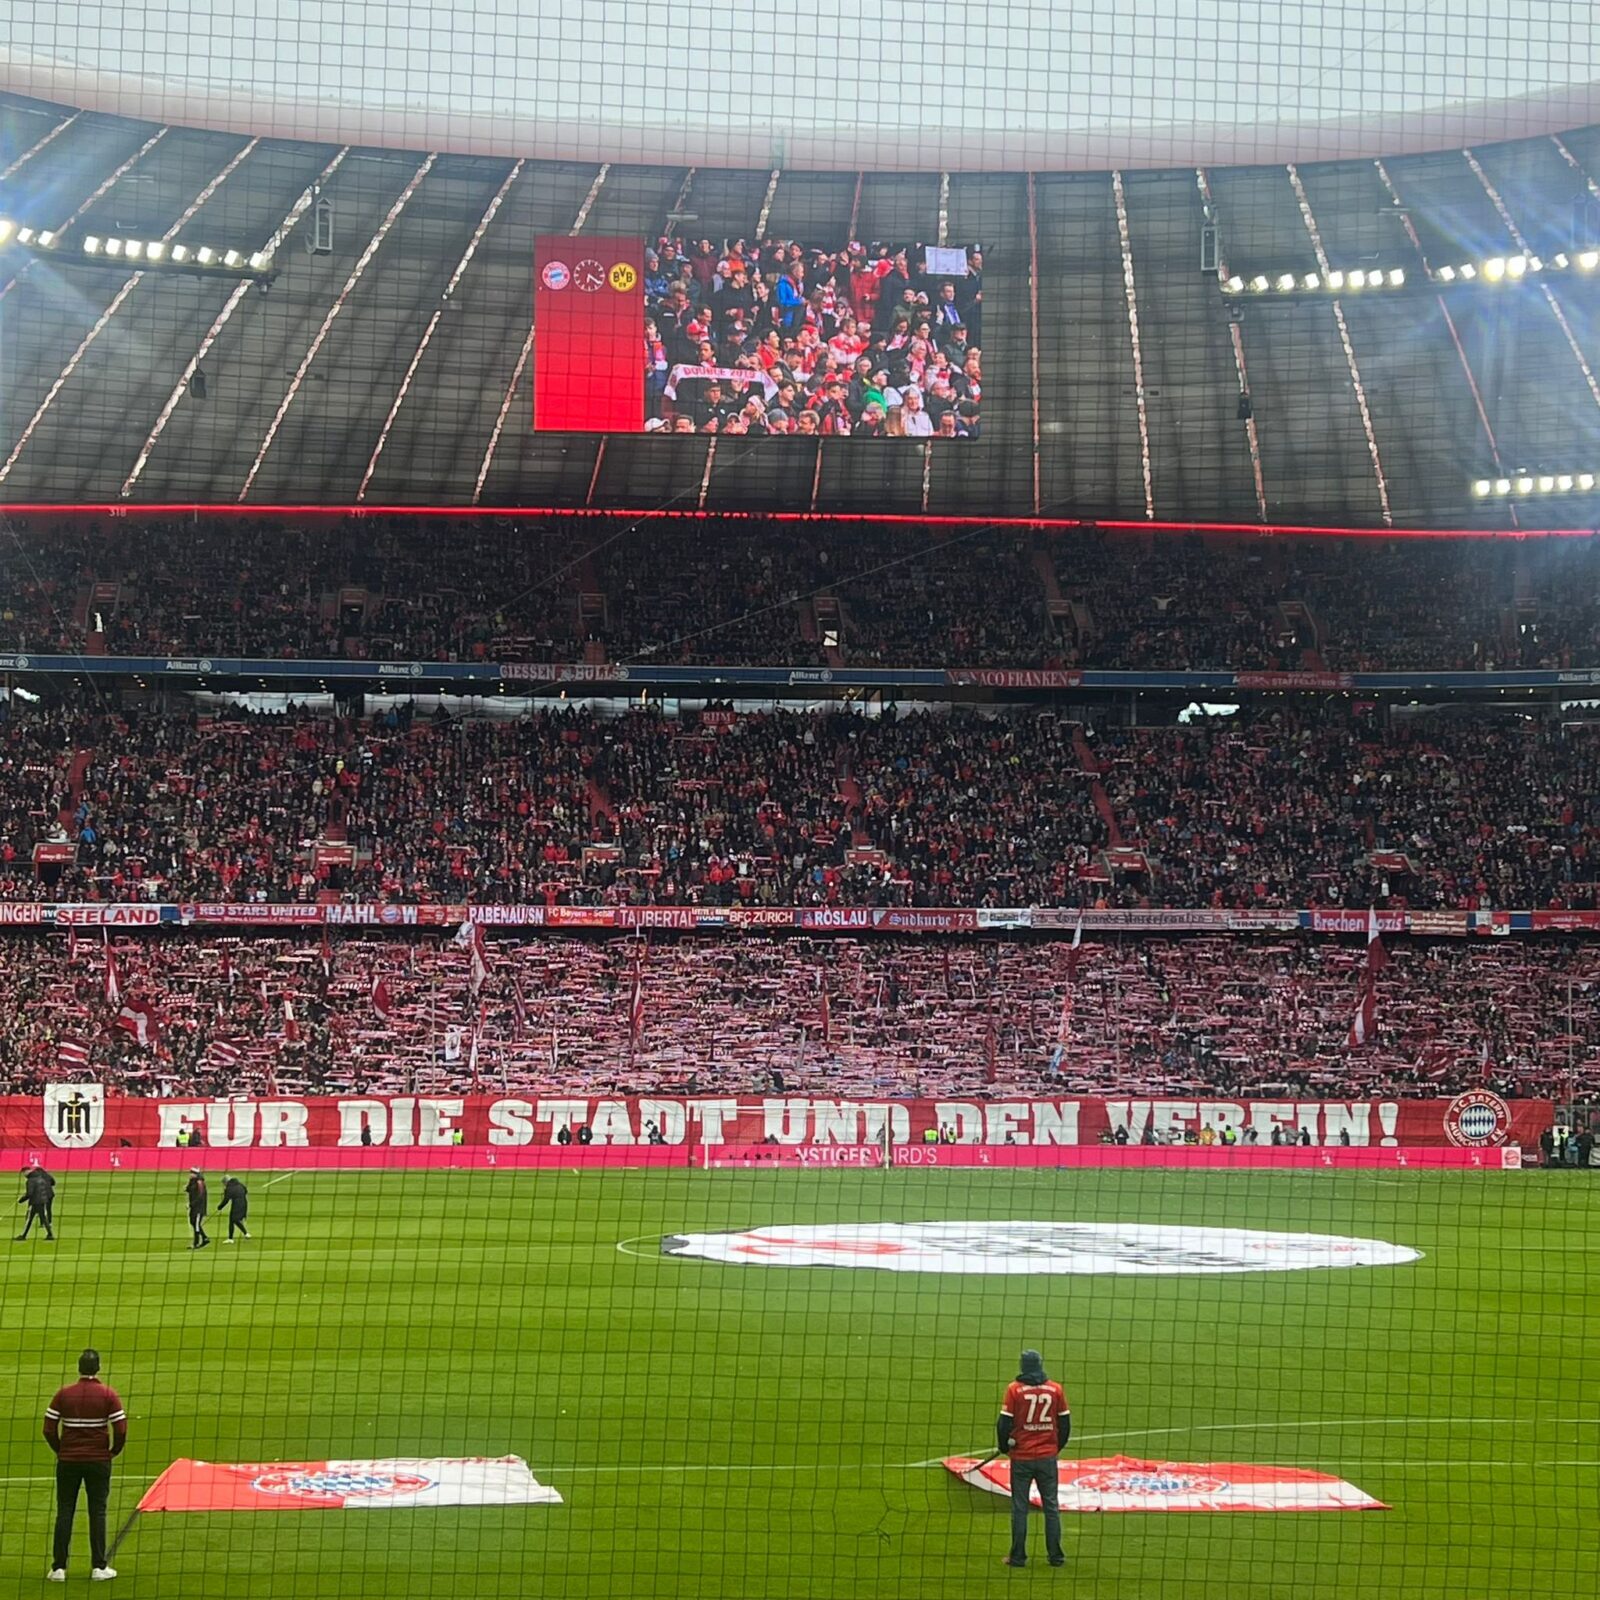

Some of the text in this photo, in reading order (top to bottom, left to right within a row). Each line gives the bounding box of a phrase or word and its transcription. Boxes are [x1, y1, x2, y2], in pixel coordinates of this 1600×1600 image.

[613, 266, 633, 283] BVB
[683, 367, 726, 376] DOUBLE
[166, 660, 198, 671] Allianz
[378, 664, 410, 675] Allianz
[500, 664, 619, 681] GIESSEN BULLS
[789, 670, 820, 682] Allianz
[1008, 671, 1067, 687] FRANKEN
[1558, 672, 1590, 683] Allianz
[56, 908, 159, 924] SEELAND
[199, 906, 317, 916] RED STARS UNITED
[730, 912, 751, 923] BFC
[620, 911, 695, 928] TAUBERTAL
[1468, 1094, 1505, 1119] BAYERN
[158, 1096, 1399, 1147] FÜR DIE STADT UND DEN VEREIN!
[1024, 1393, 1052, 1423] 72
